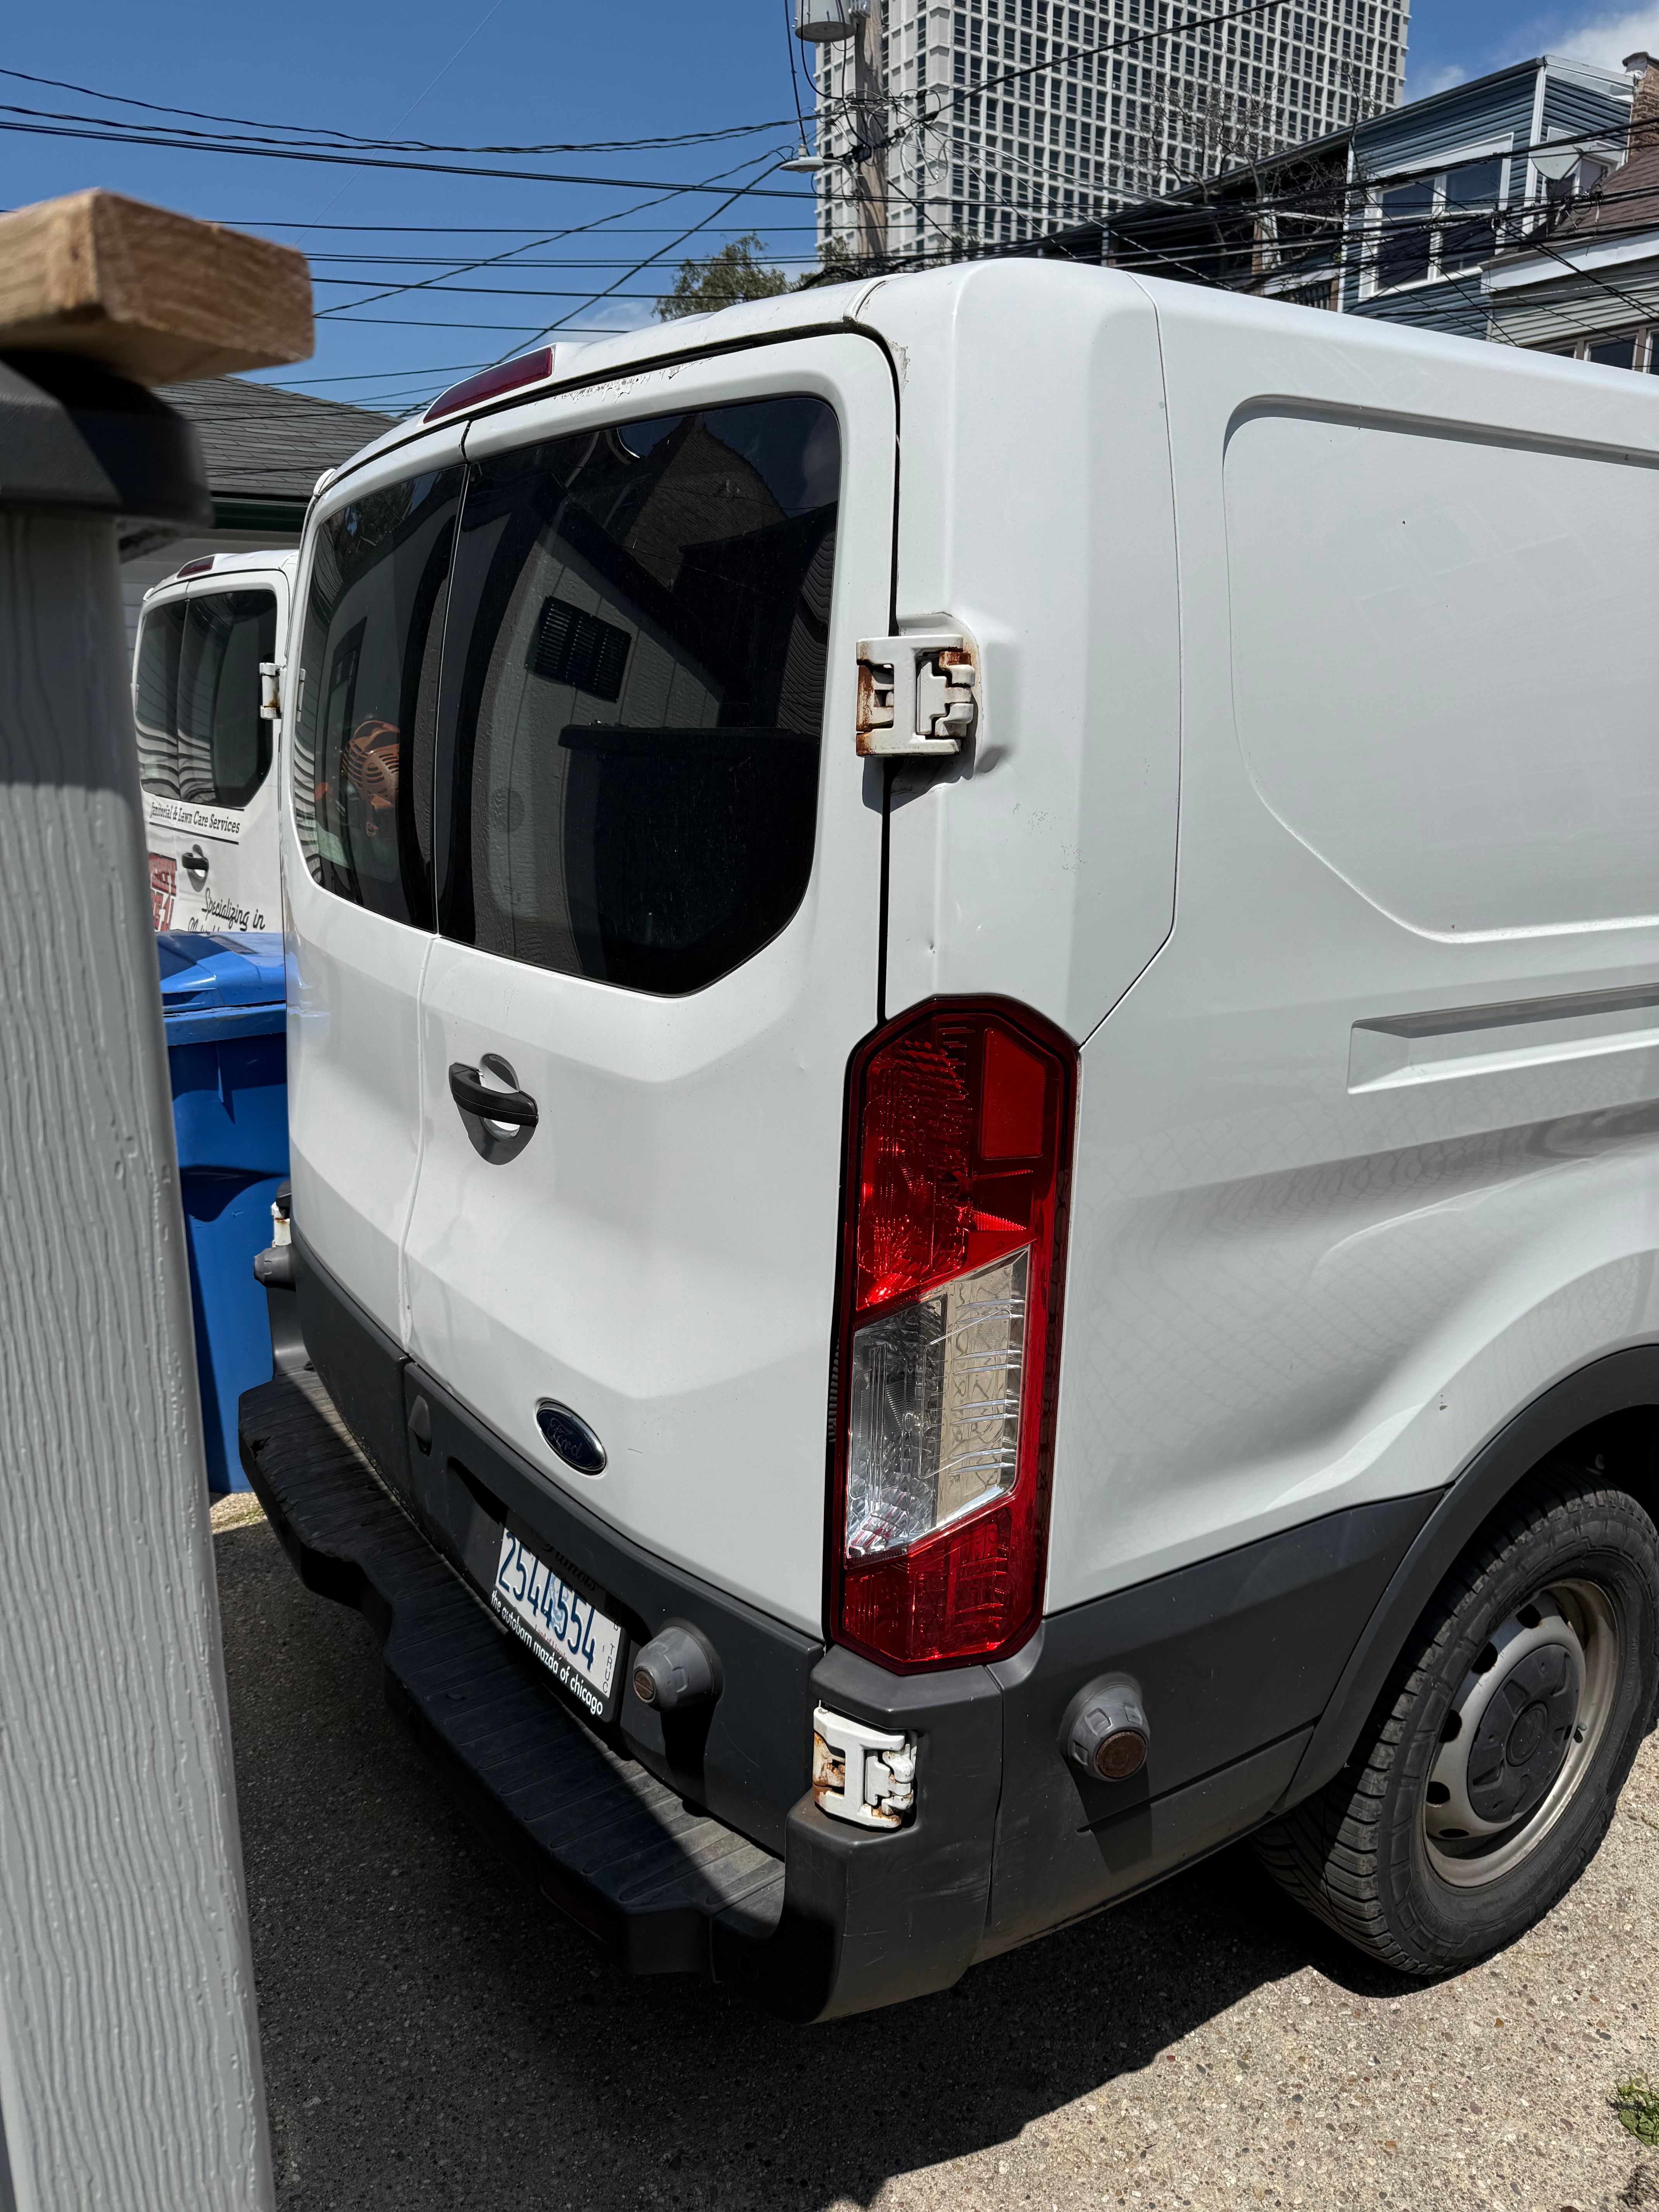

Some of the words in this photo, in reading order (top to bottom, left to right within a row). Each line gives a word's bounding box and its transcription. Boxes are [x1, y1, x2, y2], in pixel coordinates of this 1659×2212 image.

[149, 802, 173, 819] Janitorial
[173, 807, 178, 820] &
[177, 808, 192, 824] Lawn
[194, 811, 208, 827] Care
[209, 814, 240, 833] Services
[201, 887, 250, 932] Specializing
[253, 908, 266, 930] in
[547, 1418, 583, 1459] Ford
[498, 1531, 596, 1672] 2544554
[491, 1590, 501, 1613] the
[503, 1607, 532, 1649] autobarn
[533, 1642, 558, 1676] mazda
[560, 1665, 570, 1685] of
[570, 1674, 603, 1716] chicago
